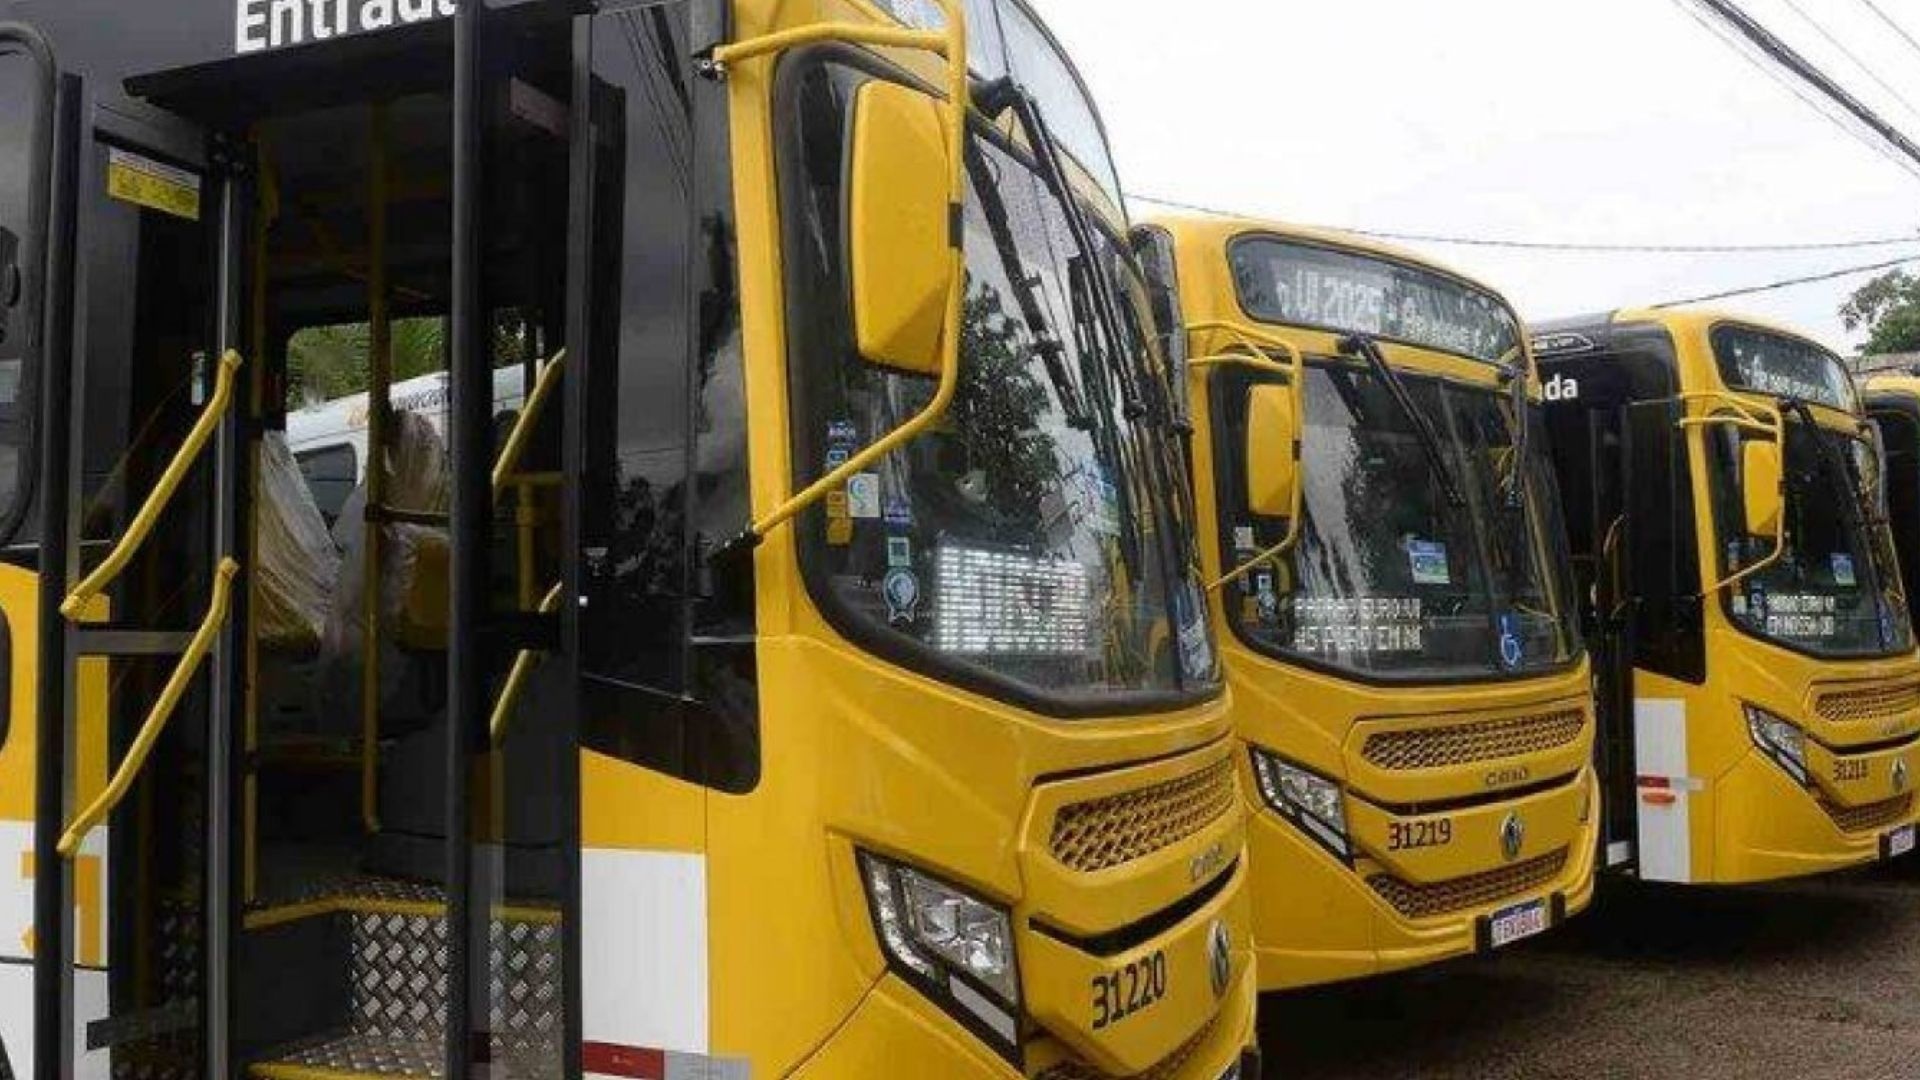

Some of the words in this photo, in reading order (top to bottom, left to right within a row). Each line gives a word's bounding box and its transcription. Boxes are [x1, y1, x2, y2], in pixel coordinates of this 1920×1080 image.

[236, 0, 456, 53] Entra
[1538, 373, 1578, 401] da
[1388, 818, 1451, 850] 31219
[1092, 951, 1166, 1030] 31220
